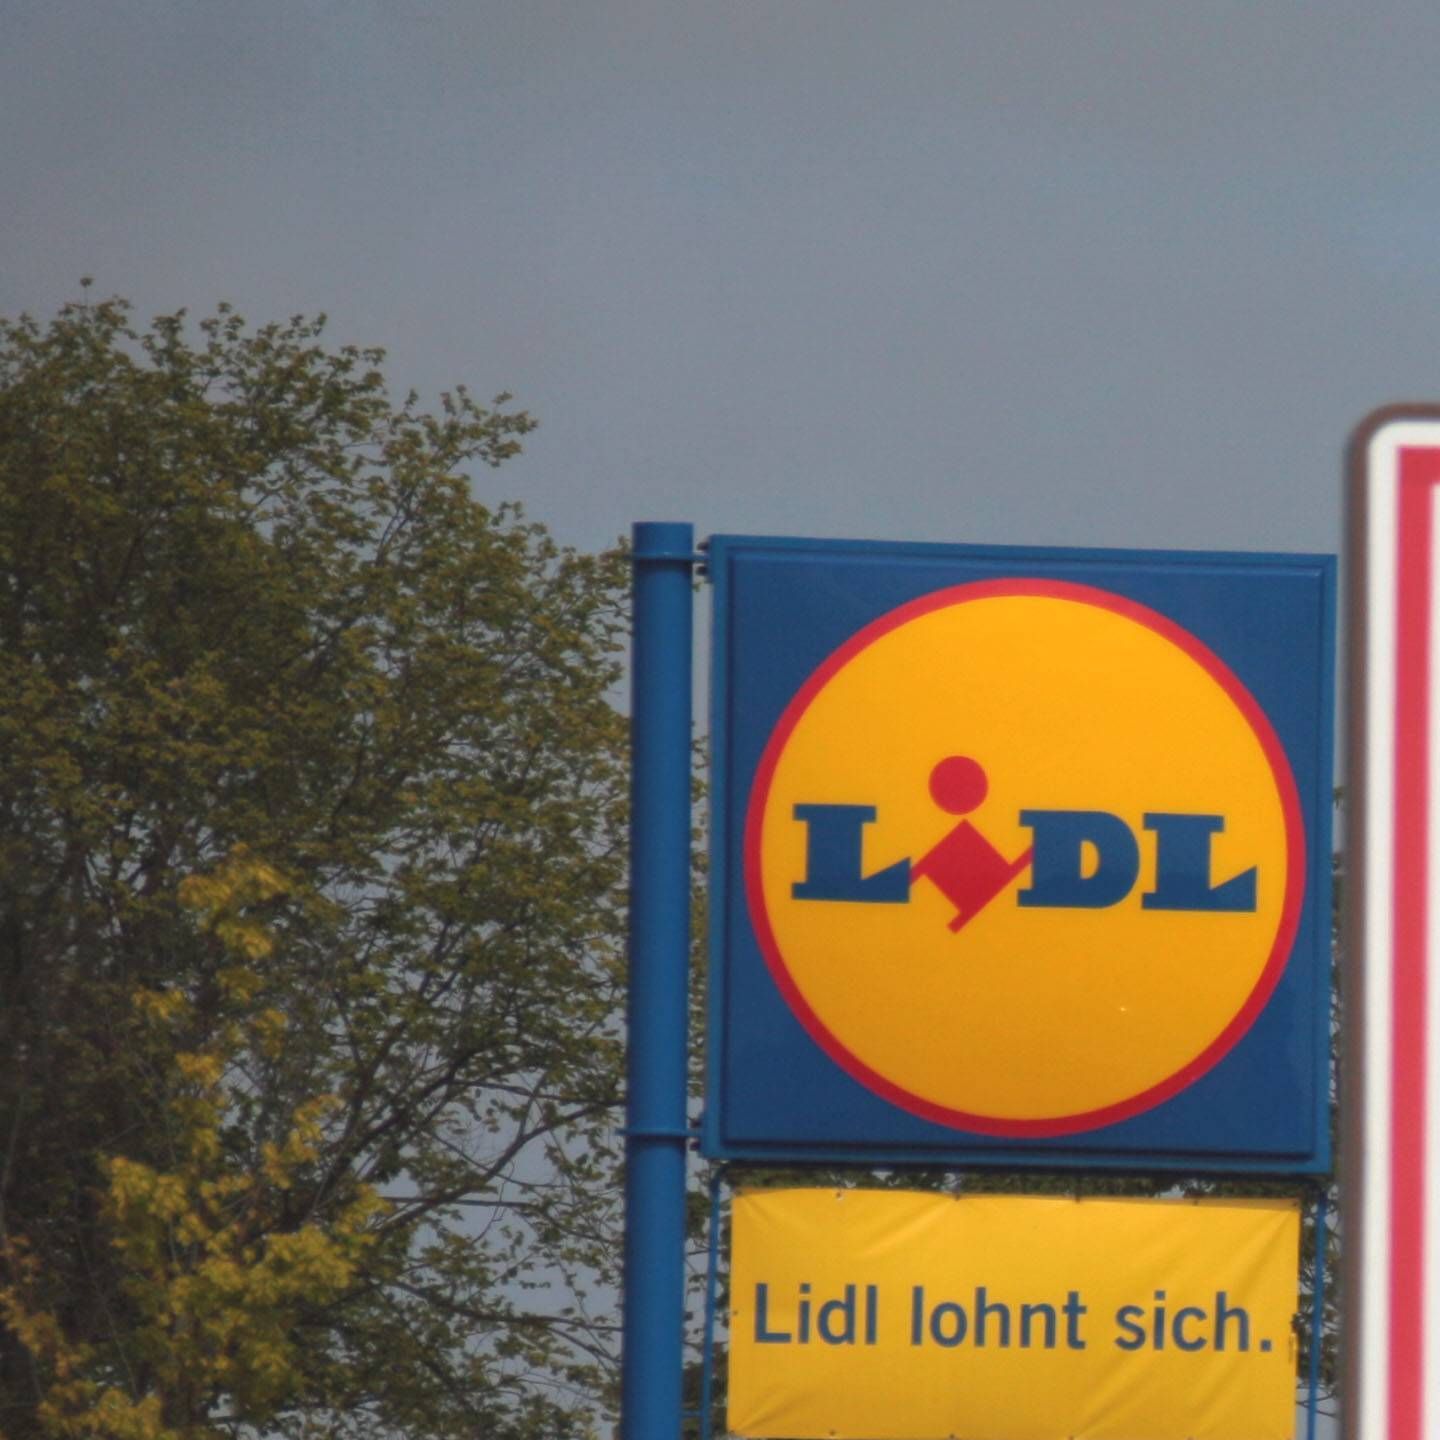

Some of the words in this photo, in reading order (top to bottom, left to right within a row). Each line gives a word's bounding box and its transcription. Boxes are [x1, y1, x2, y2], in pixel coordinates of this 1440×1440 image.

[753, 1283, 878, 1345] Lidl
[910, 1285, 1087, 1350] lohnt
[1114, 1290, 1273, 1352] sich.
